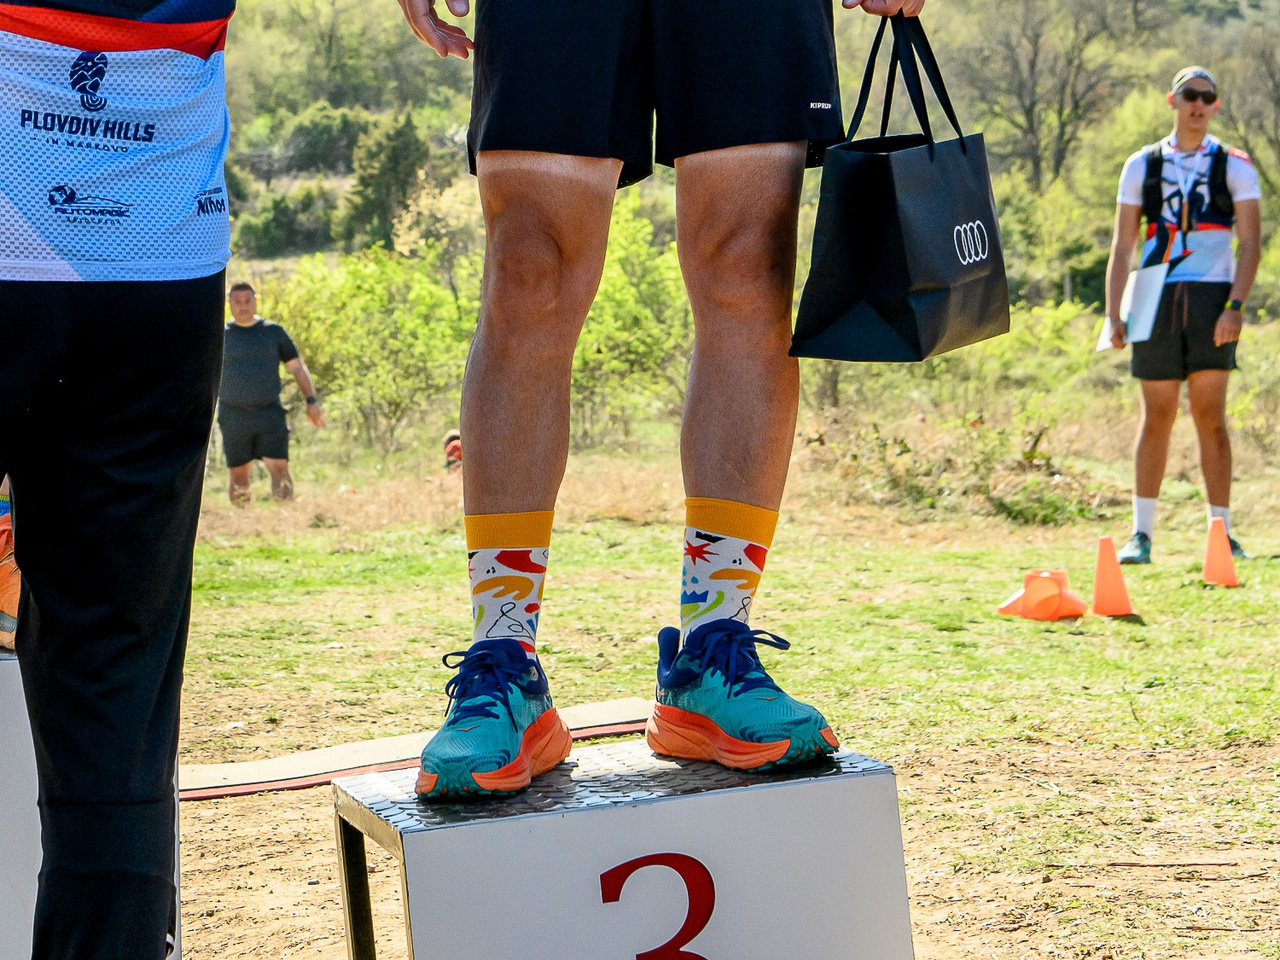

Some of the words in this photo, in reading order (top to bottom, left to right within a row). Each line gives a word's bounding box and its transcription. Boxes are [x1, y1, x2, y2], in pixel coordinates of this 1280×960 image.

[20, 109, 103, 138] PLOVDIV
[103, 119, 156, 143] HILLS
[46, 137, 59, 145] IN
[66, 140, 130, 153] MARKOVO
